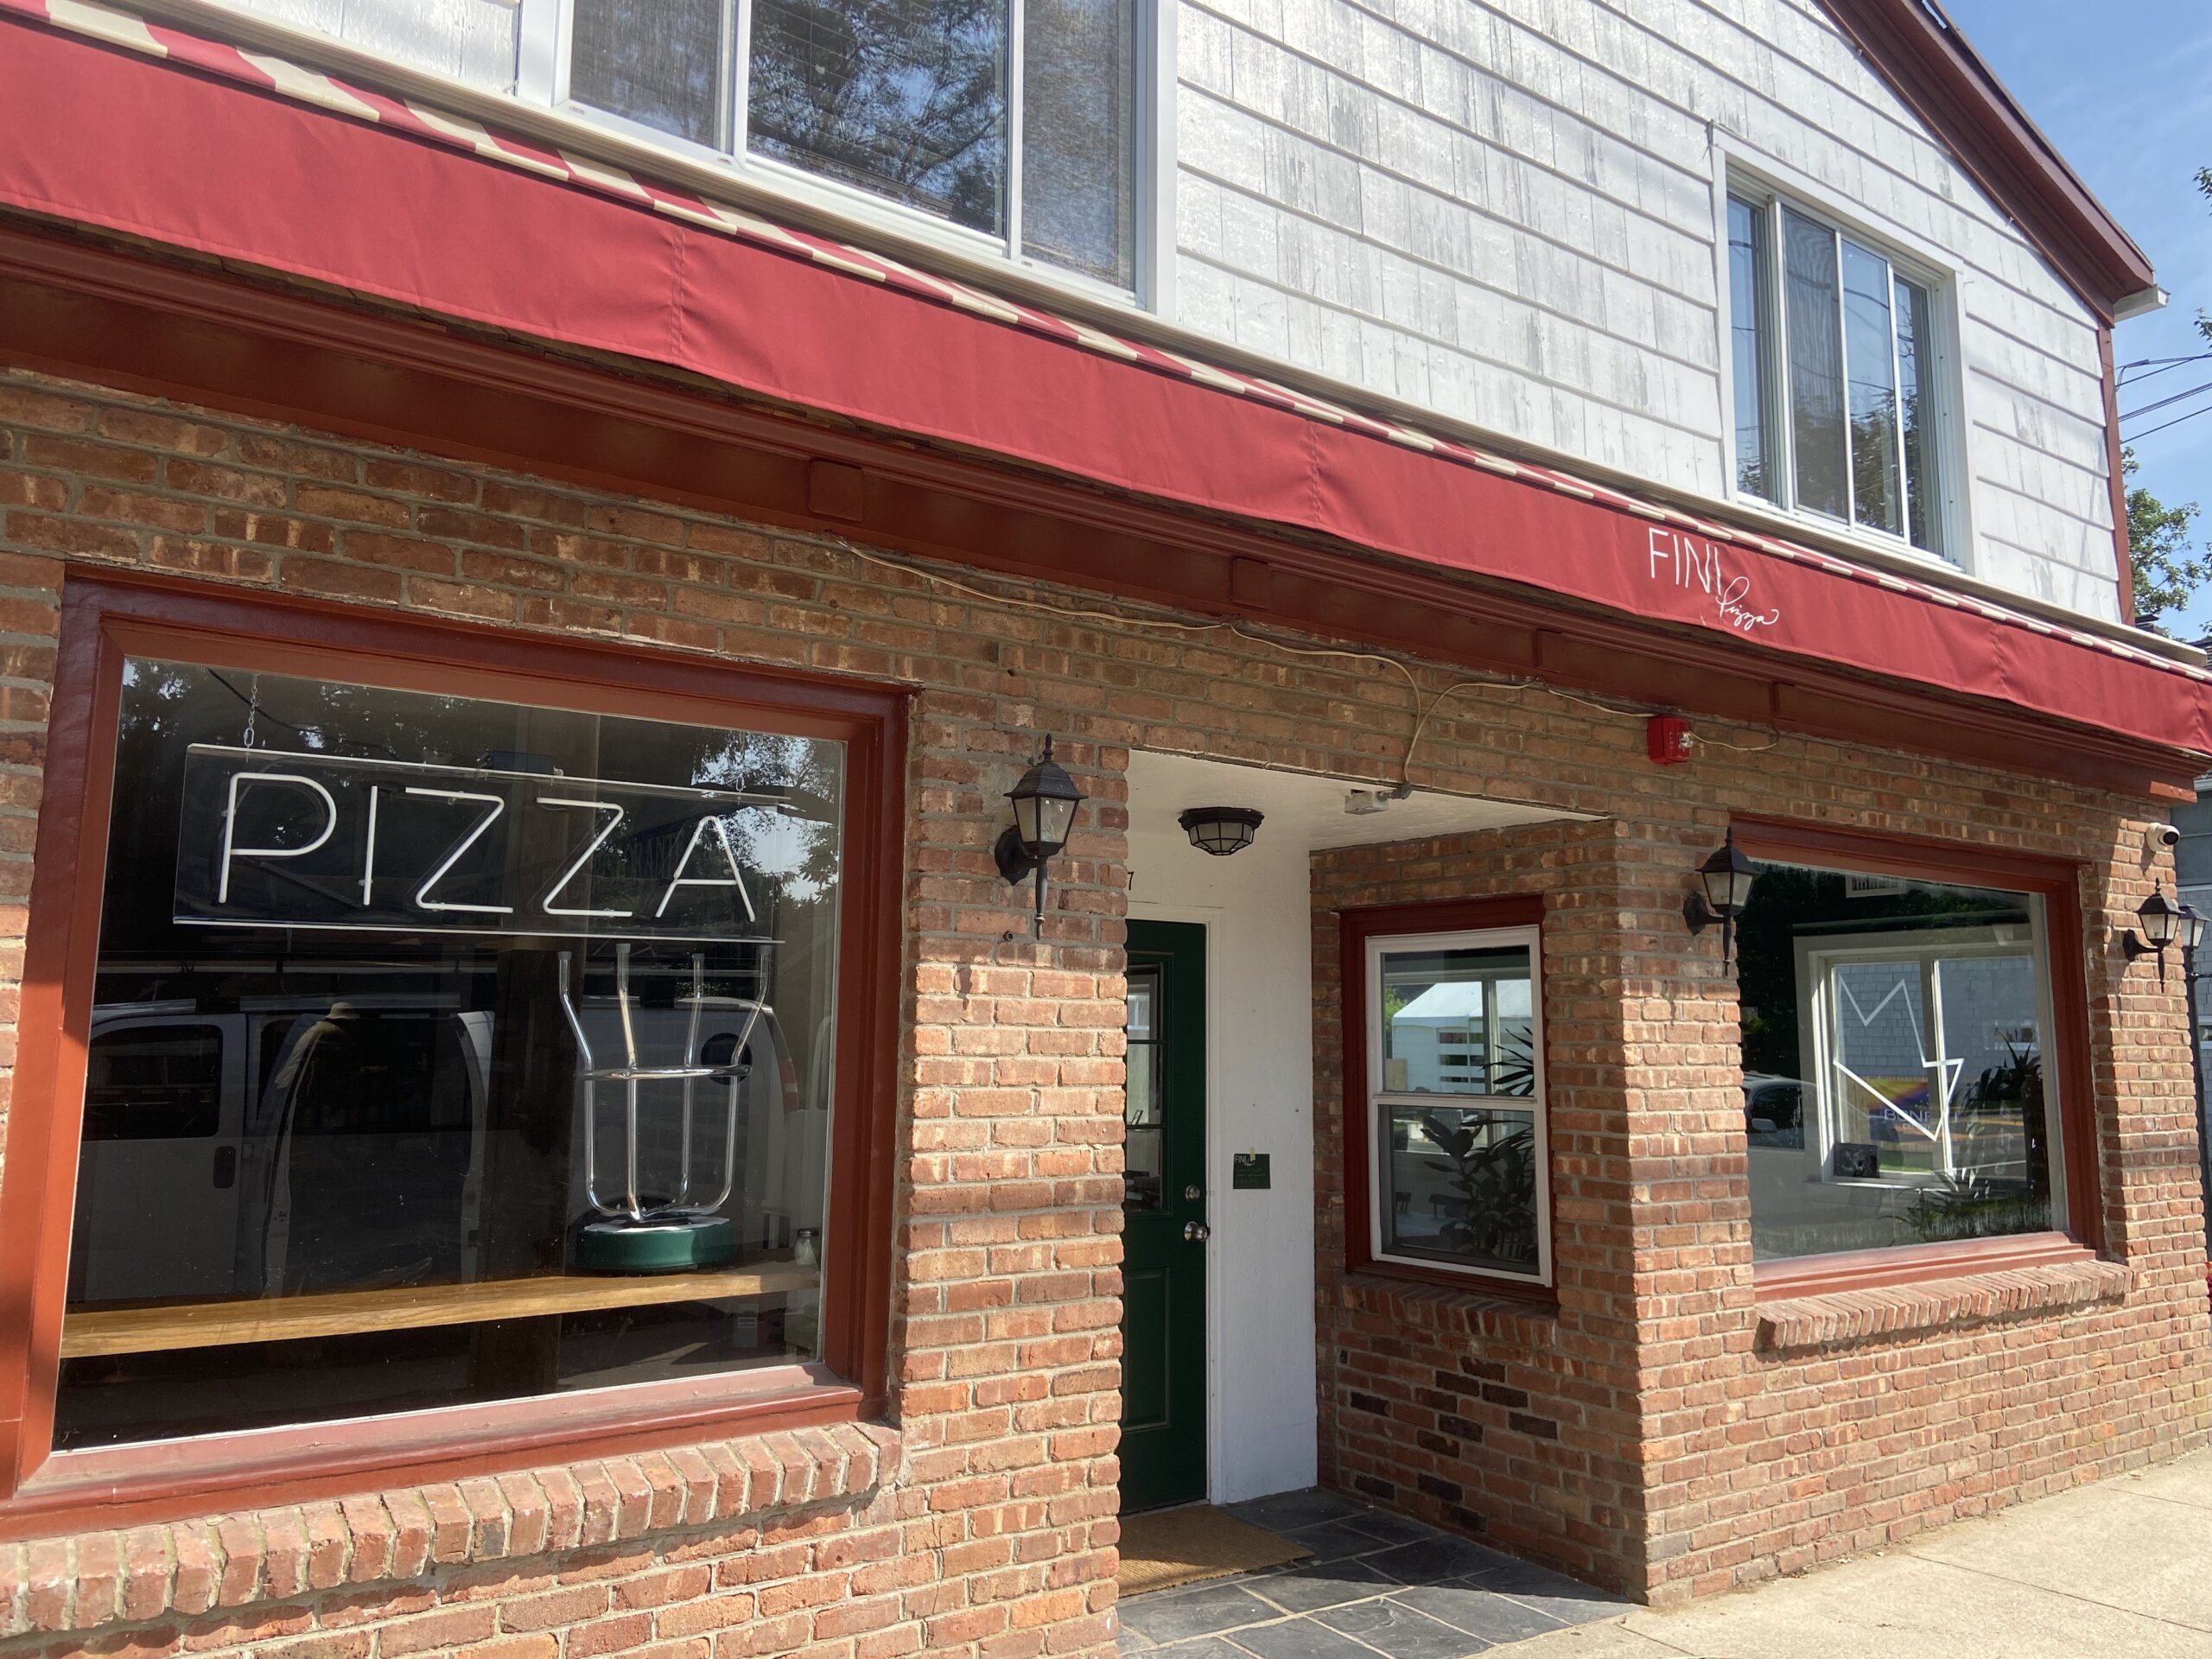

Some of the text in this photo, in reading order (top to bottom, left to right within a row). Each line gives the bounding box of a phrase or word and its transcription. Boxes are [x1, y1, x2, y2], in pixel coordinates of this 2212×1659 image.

[1648, 527, 1721, 596] FINI
[1715, 575, 1780, 631] Pizza
[218, 771, 756, 924] PIZZA
